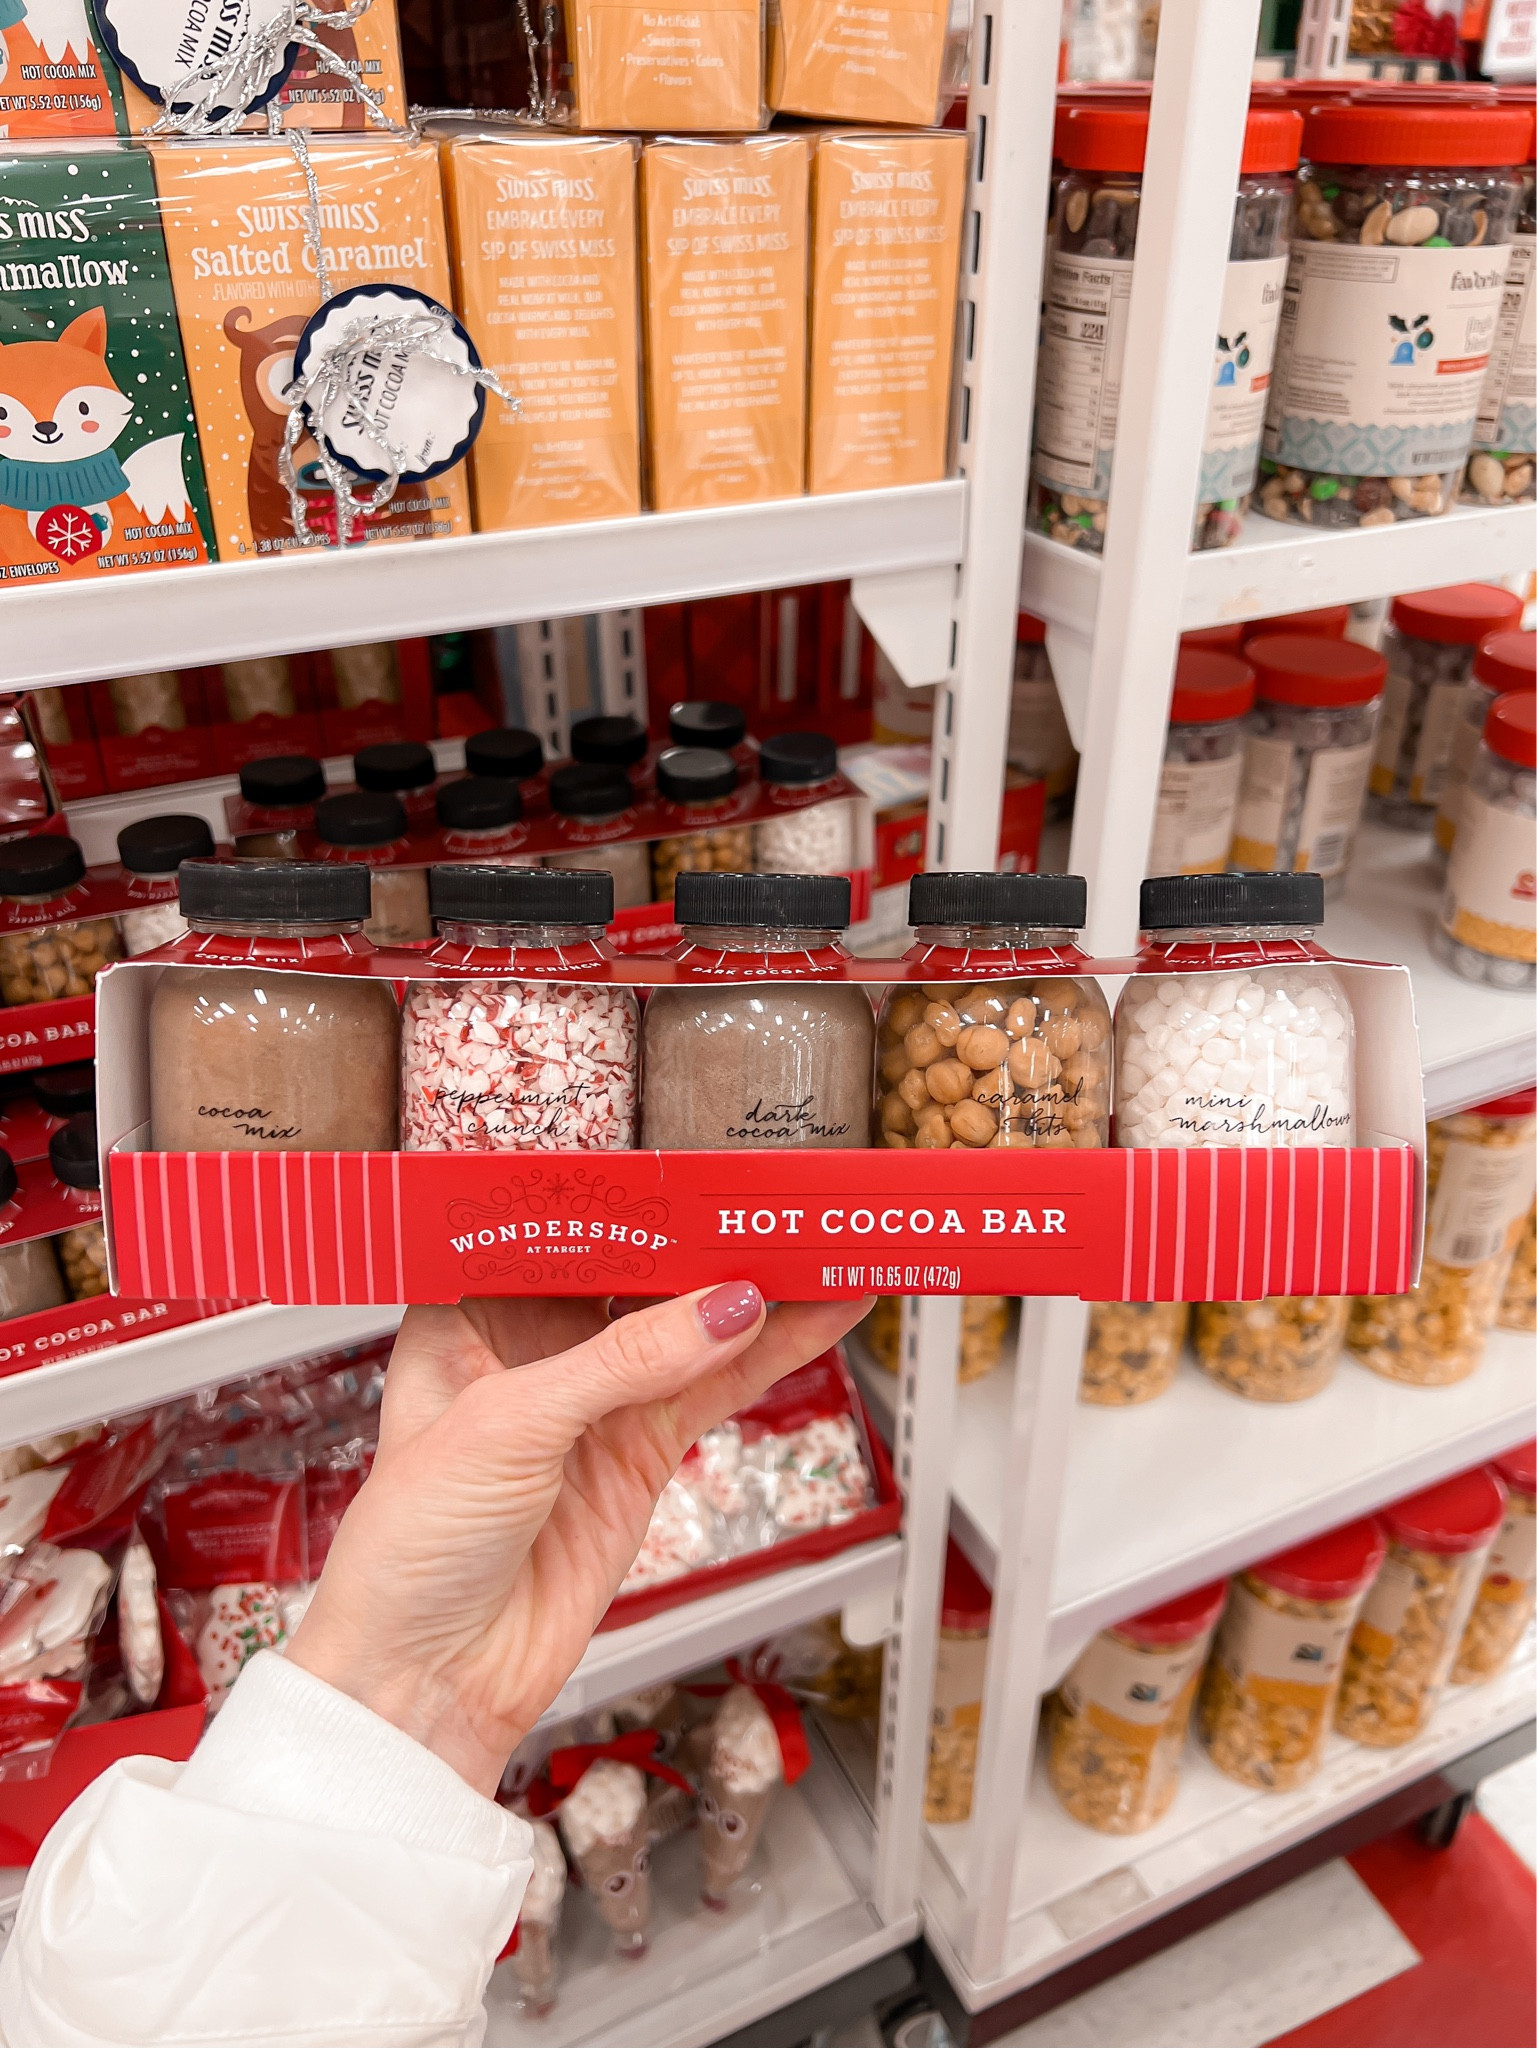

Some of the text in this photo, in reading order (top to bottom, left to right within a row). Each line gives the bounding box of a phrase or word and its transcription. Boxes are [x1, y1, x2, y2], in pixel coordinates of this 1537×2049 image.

[642, 14, 701, 28] No Artificial
[174, 33, 199, 69] MIX
[626, 54, 724, 67] Preservatives Colors
[21, 64, 97, 80] HOT COCOA MIX
[659, 73, 692, 86] Flavors
[12, 96, 27, 110] WT
[29, 95, 51, 109] 5.52
[54, 95, 67, 109] OZ
[69, 94, 102, 111] (156g)
[288, 88, 355, 103] NET WT 5.52 OZ
[486, 209, 605, 230] EMBRACE EVERY
[672, 204, 781, 227] EMBRACE EVERY
[191, 237, 428, 280] Salted Caramel
[481, 238, 616, 261] SIP OF SWISS MISS
[212, 279, 295, 302] FLAVORED WITH
[124, 521, 194, 541] HOT COCOA MIX
[97, 546, 199, 570] NET WT 5.52 OZ (156g)
[9, 561, 60, 579] ENVELOPES
[194, 953, 299, 964] COCOA MIX
[424, 960, 602, 972] PEPPERMINT CRUNCH
[952, 962, 1077, 974] CARAMEL BITS
[691, 964, 838, 976] DARK COCOA MIX
[44, 1020, 92, 1043] BAR
[432, 1082, 592, 1113] peppermint
[977, 1076, 1084, 1107] caramel
[1184, 1094, 1253, 1109] mini
[197, 1104, 273, 1120] cocoa
[744, 1094, 817, 1124] dark
[1168, 1103, 1353, 1134] marshmallows
[232, 1122, 302, 1140] mix
[466, 1107, 571, 1137] crunch
[726, 1121, 851, 1139] cocoa mix
[1003, 1107, 1067, 1137] bits
[718, 1208, 1068, 1235] HOT COCOA BAR
[526, 1245, 592, 1254] AT TARGET
[821, 1266, 962, 1290] NET WT 16.65 OZ (472g)
[0, 1342, 26, 1363] OT
[34, 1318, 116, 1352] COCOA
[120, 1302, 170, 1328] BAR
